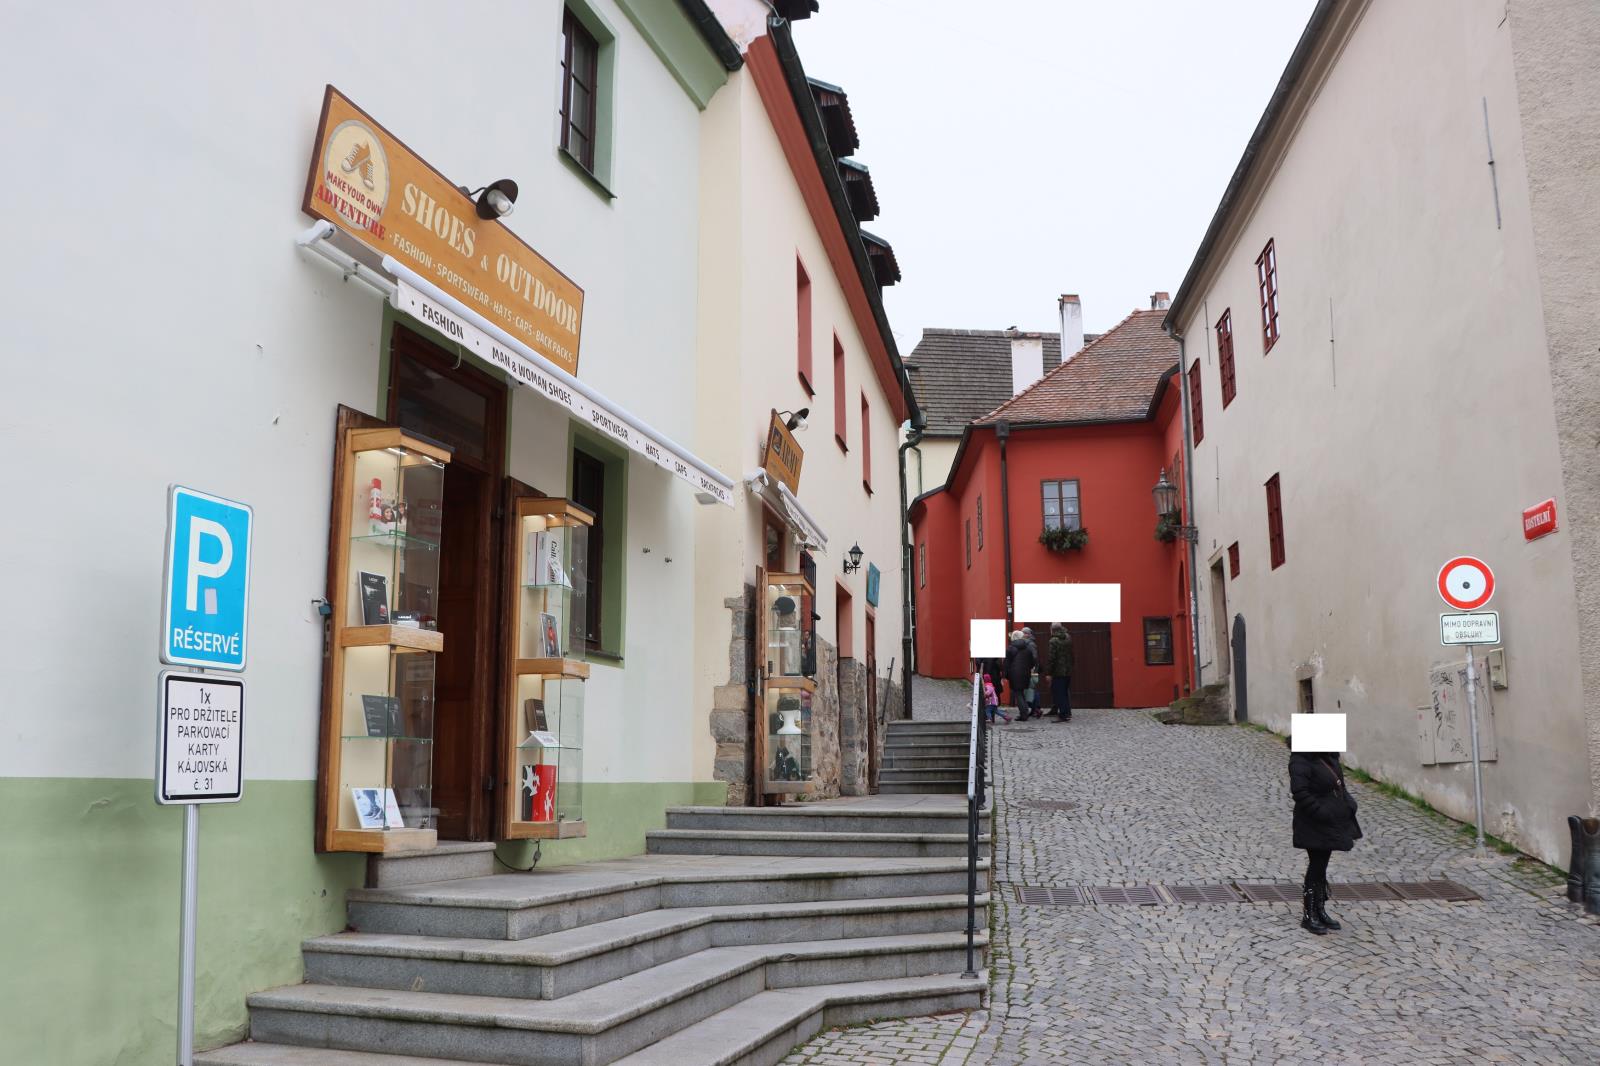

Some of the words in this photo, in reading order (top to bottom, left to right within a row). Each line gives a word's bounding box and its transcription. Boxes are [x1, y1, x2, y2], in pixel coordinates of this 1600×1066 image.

[327, 170, 346, 192] MAKE
[347, 184, 365, 205] YOUR
[366, 199, 382, 216] OWN
[315, 183, 386, 240] ADVENTURE
[401, 182, 476, 258] SHOES
[480, 254, 489, 272] &
[496, 253, 577, 335] OUTDOOR
[393, 232, 433, 269] FASHION
[437, 262, 489, 306] SPORTSWEAR
[493, 300, 512, 322] HATS
[515, 315, 532, 336] CAPS
[422, 302, 464, 340] FASHION
[492, 346, 510, 369] MAN
[511, 360, 517, 373] &
[518, 363, 547, 392] WOMAN
[548, 382, 572, 406] SHOES
[591, 409, 629, 441] SPORTWEAR
[645, 442, 660, 460] HATS
[674, 461, 688, 477] CAPS
[185, 514, 234, 612] P
[1444, 620, 1460, 628] MIMO
[173, 625, 240, 656] RÉSERVÉ
[199, 688, 211, 704] 1x
[170, 707, 190, 720] PRO
[193, 706, 238, 722] DRŽITELE
[177, 724, 230, 739] PARKOVACÍ
[188, 743, 220, 756] KARTY
[177, 757, 228, 773] KÁJOVSKÁ
[193, 778, 201, 790] č.
[204, 777, 213, 790] 31
